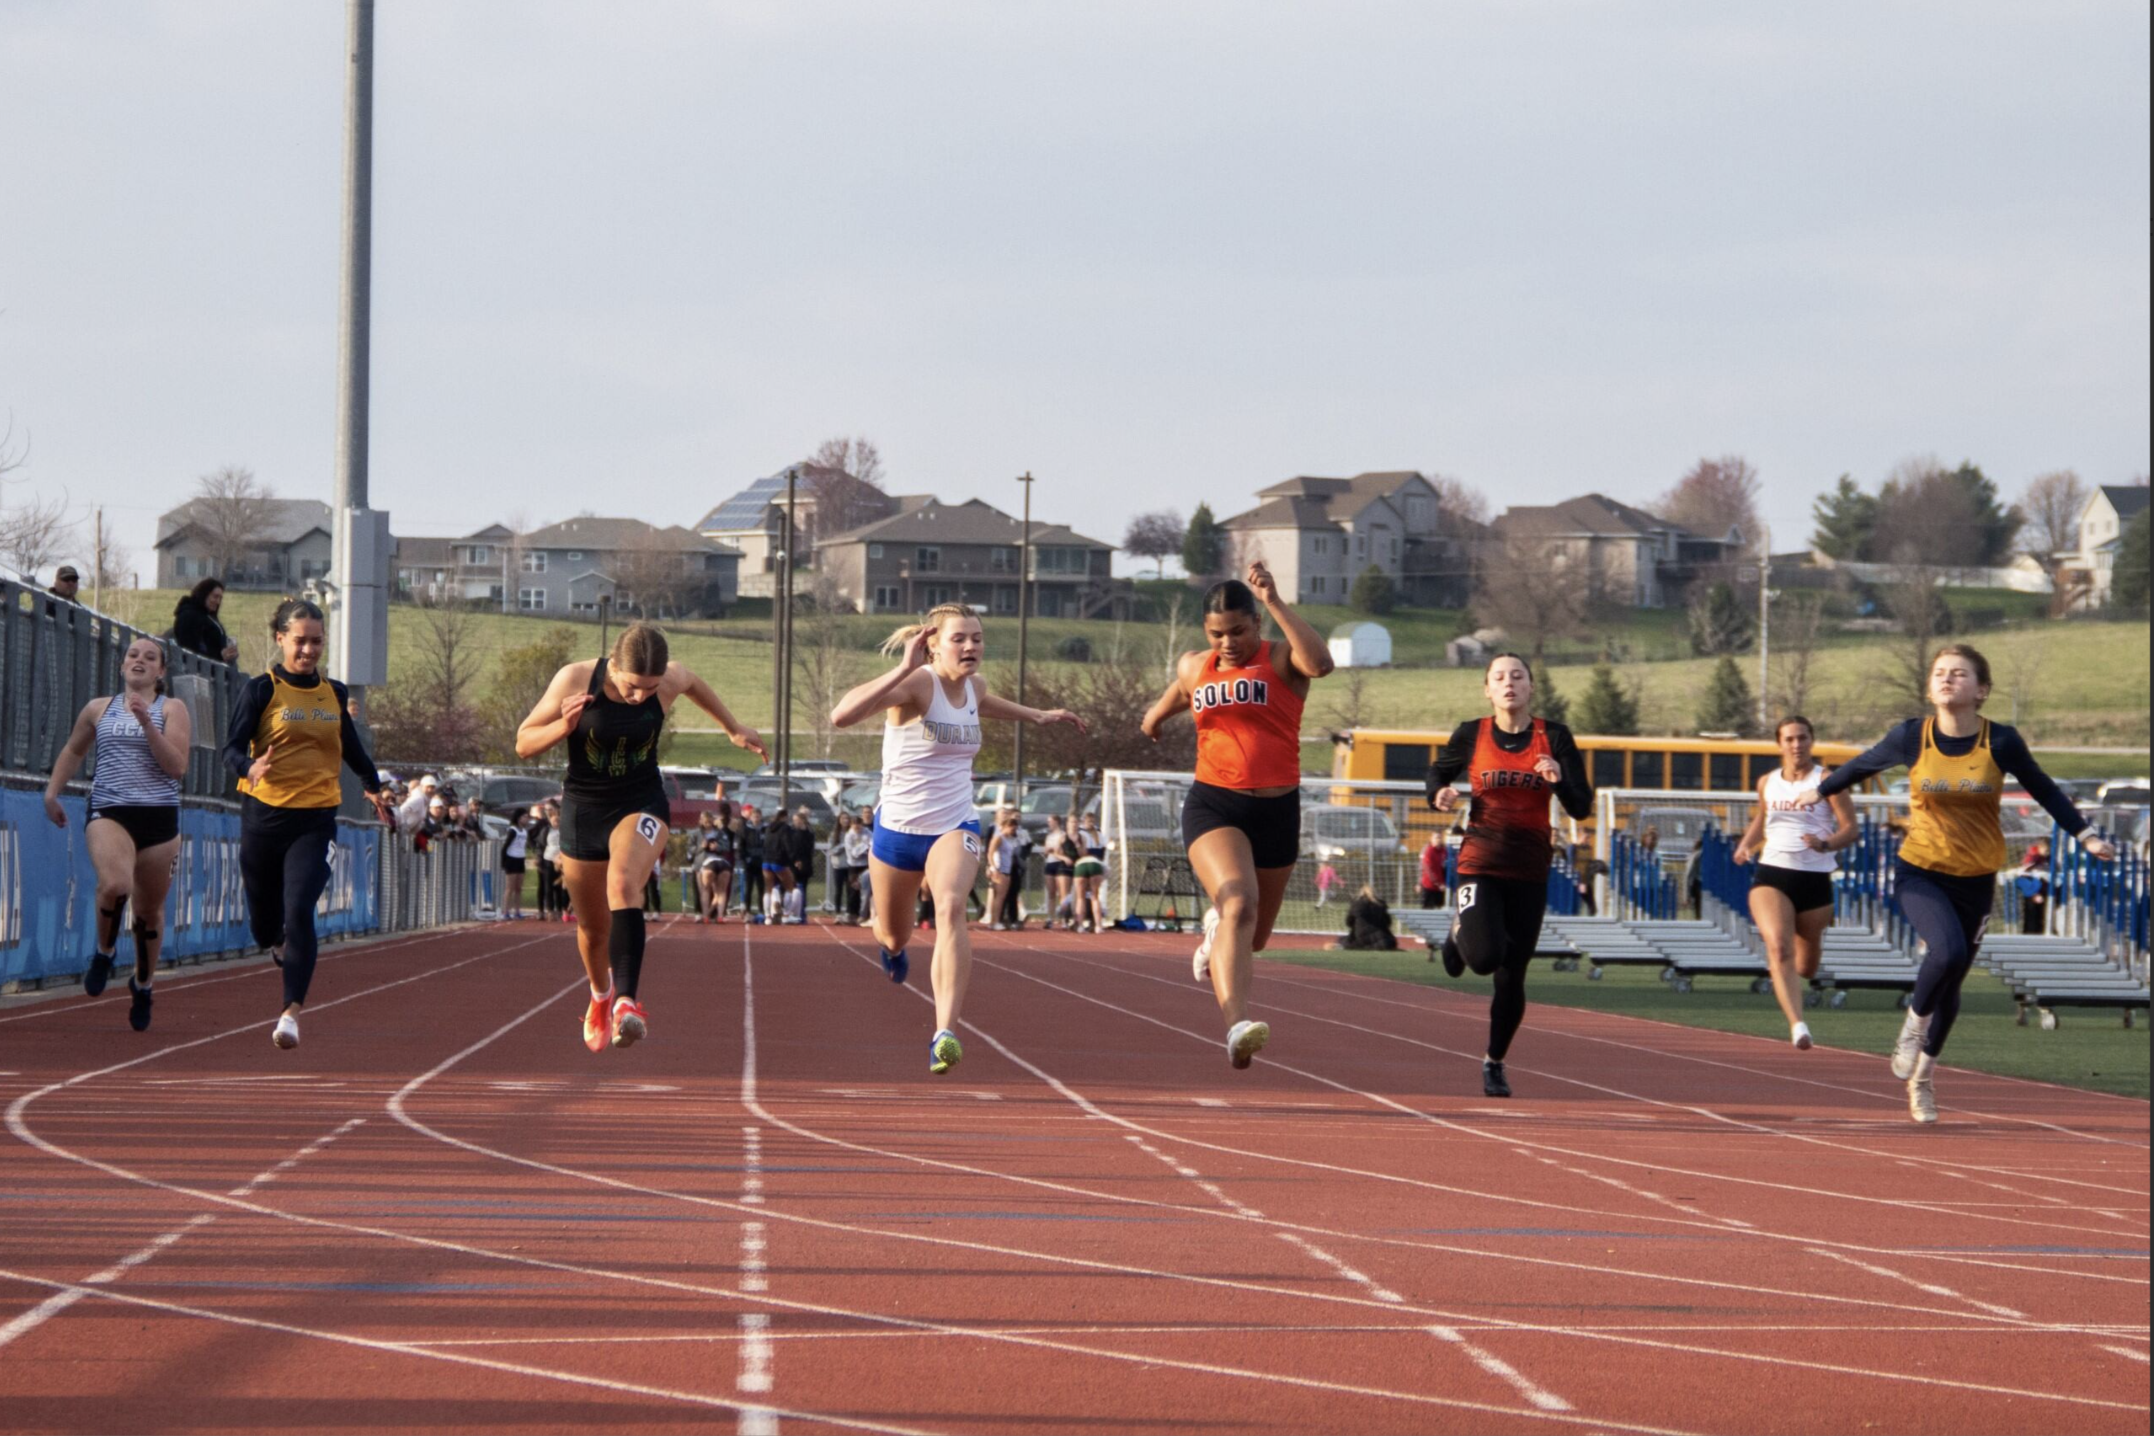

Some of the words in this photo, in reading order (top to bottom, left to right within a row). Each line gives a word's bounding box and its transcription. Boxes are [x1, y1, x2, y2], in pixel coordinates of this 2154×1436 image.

[1193, 678, 1268, 713] SOLON
[281, 707, 305, 721] Belle
[1481, 769, 1544, 792] TIGERS
[1921, 778, 1948, 793] Belle
[640, 816, 657, 840] 6
[966, 836, 979, 857] 5
[1460, 886, 1472, 908] 3
